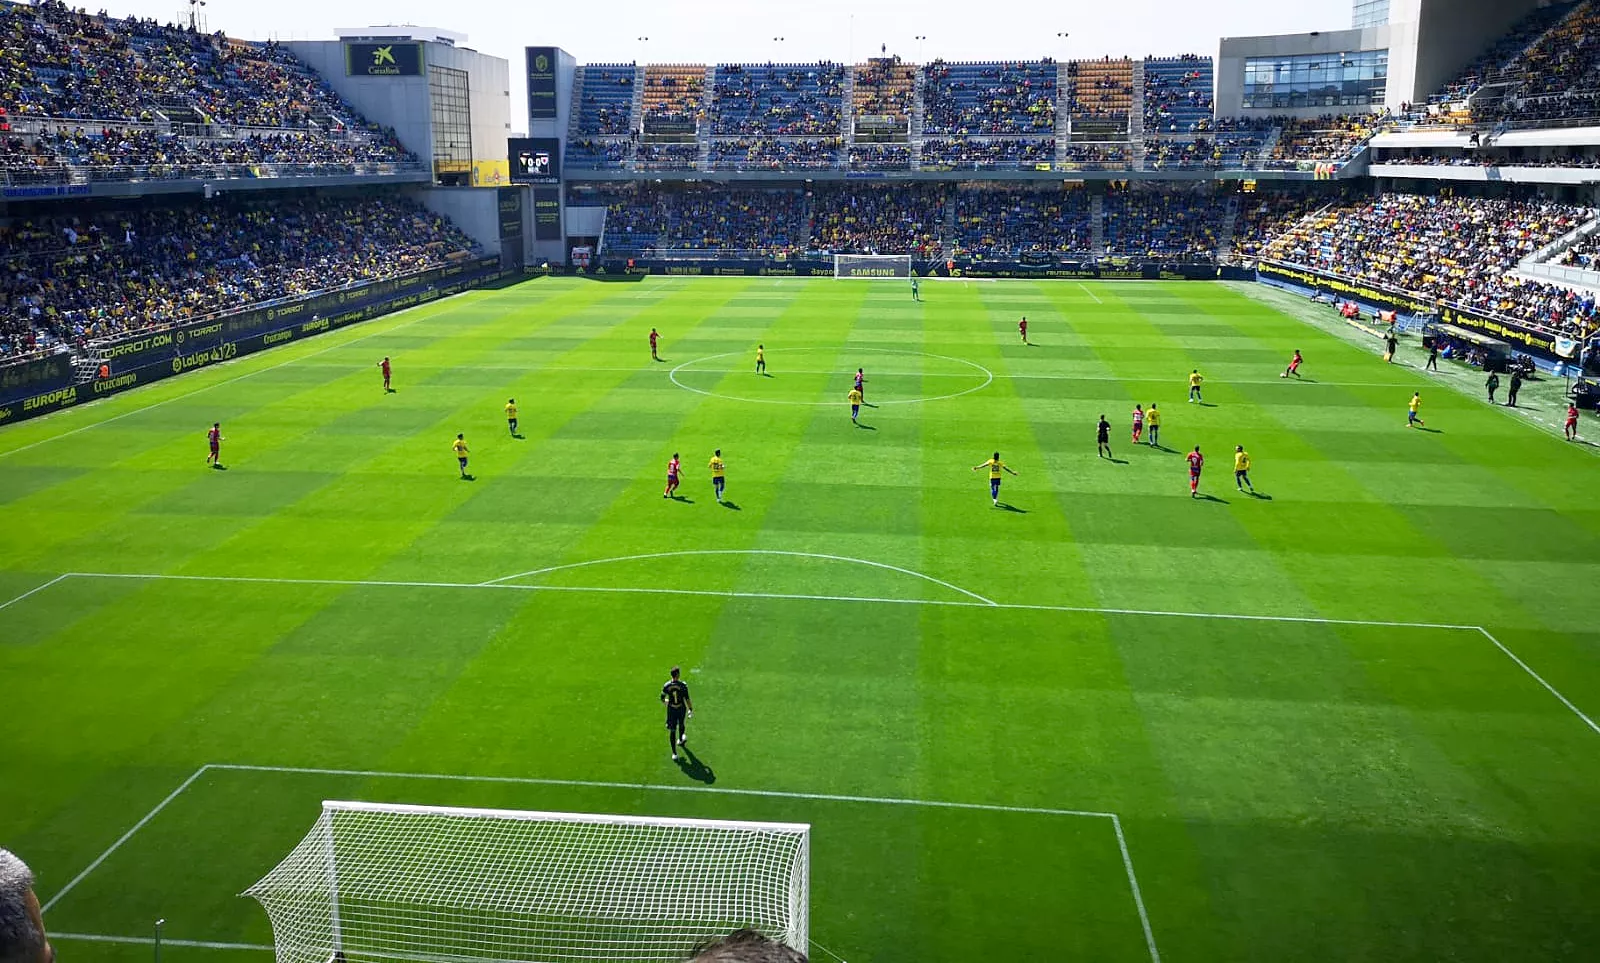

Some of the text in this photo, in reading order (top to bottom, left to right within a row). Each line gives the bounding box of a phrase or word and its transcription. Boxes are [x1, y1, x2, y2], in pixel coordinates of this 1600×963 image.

[850, 268, 895, 276] SAMSUNG
[276, 304, 304, 316] TORROT
[188, 323, 223, 338] TORROT
[182, 352, 209, 368] LaLiga
[94, 373, 137, 393] Cruzcampo
[23, 387, 77, 411] EUROPEA
